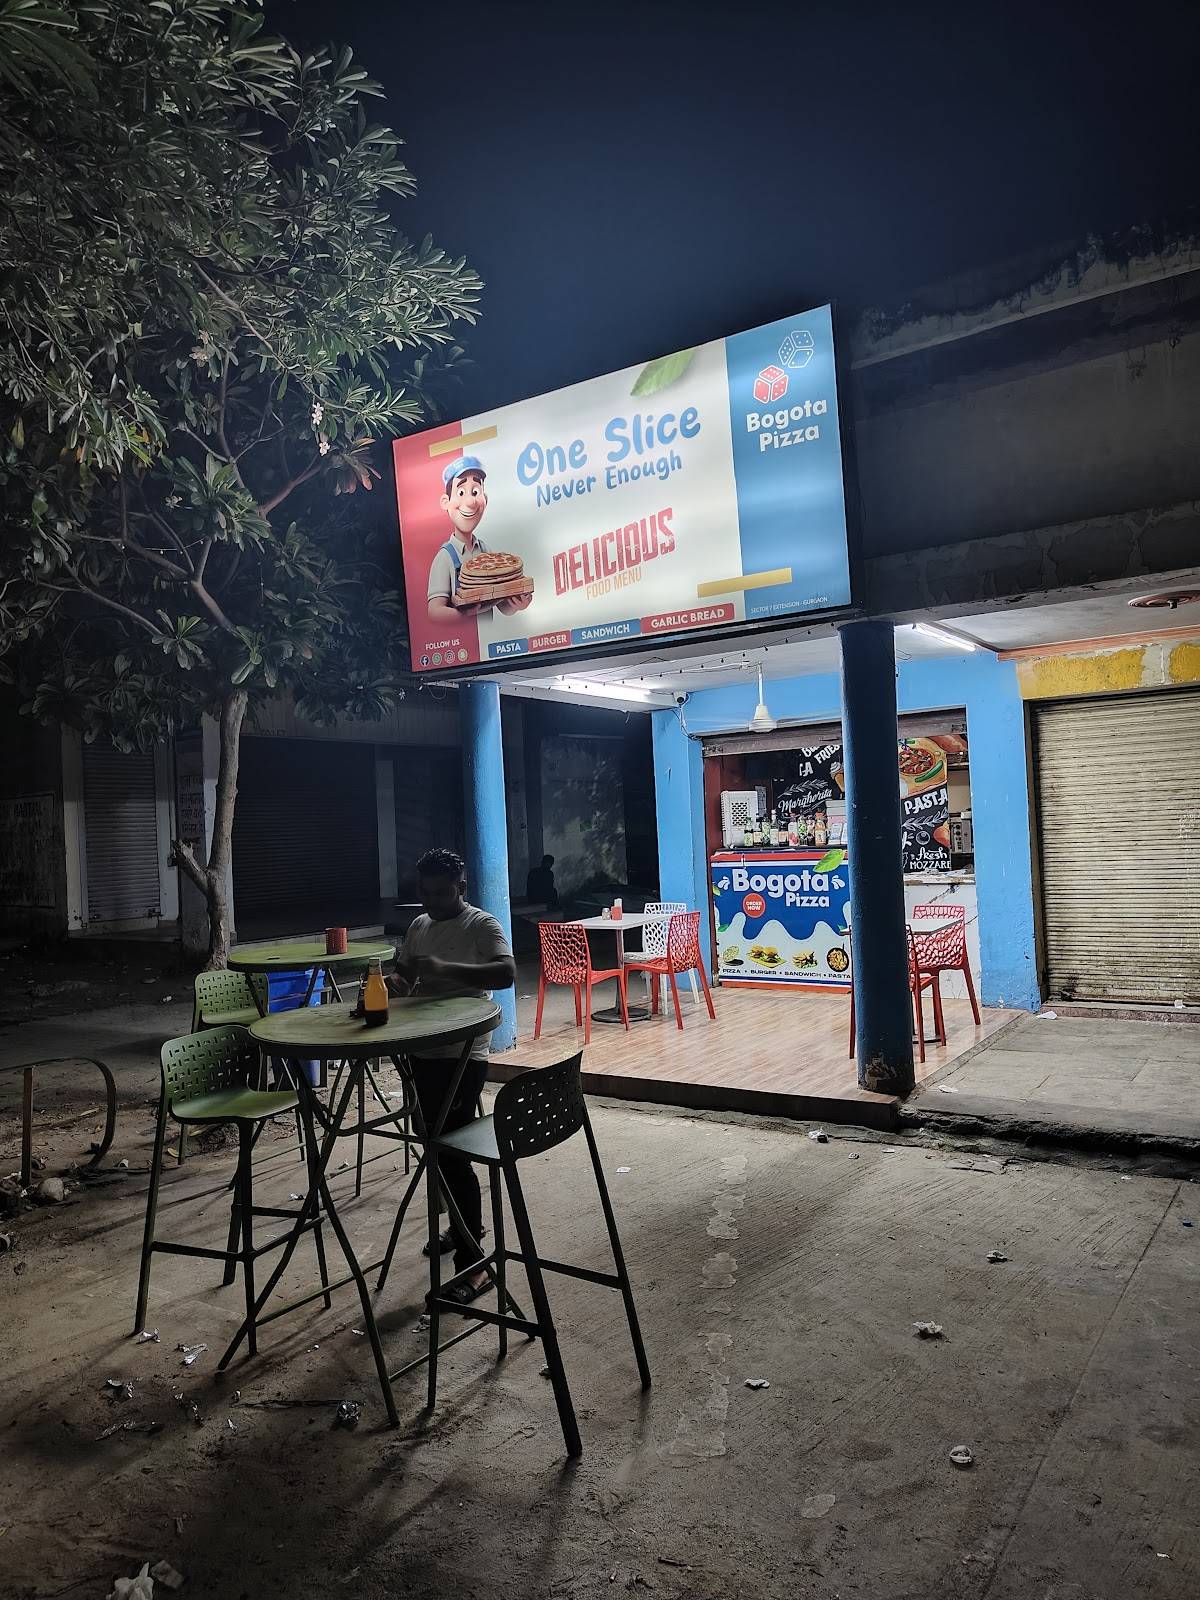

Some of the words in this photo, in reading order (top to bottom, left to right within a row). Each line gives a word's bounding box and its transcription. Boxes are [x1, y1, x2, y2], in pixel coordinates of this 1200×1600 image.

[746, 399, 828, 433] Bogota
[516, 439, 588, 486] One
[604, 406, 701, 463] Slice
[759, 424, 820, 453] Pizza
[536, 474, 597, 508] Never
[604, 449, 682, 490] Enough
[552, 507, 676, 596] DELICIOUS
[586, 578, 612, 601] FOOD
[613, 566, 642, 592] MENU
[773, 600, 800, 611] EXTENSION
[650, 613, 689, 629] GARLIC
[689, 608, 725, 623] BREAD
[425, 639, 451, 651] FOLLOW
[451, 638, 461, 647] US
[532, 634, 568, 649] BURGER
[581, 623, 631, 641] SANDWICH
[495, 642, 522, 654] PASTA
[903, 787, 949, 816] PASTA
[915, 846, 948, 861] fresh
[731, 867, 830, 898] Bogota
[785, 891, 830, 908] Pizza
